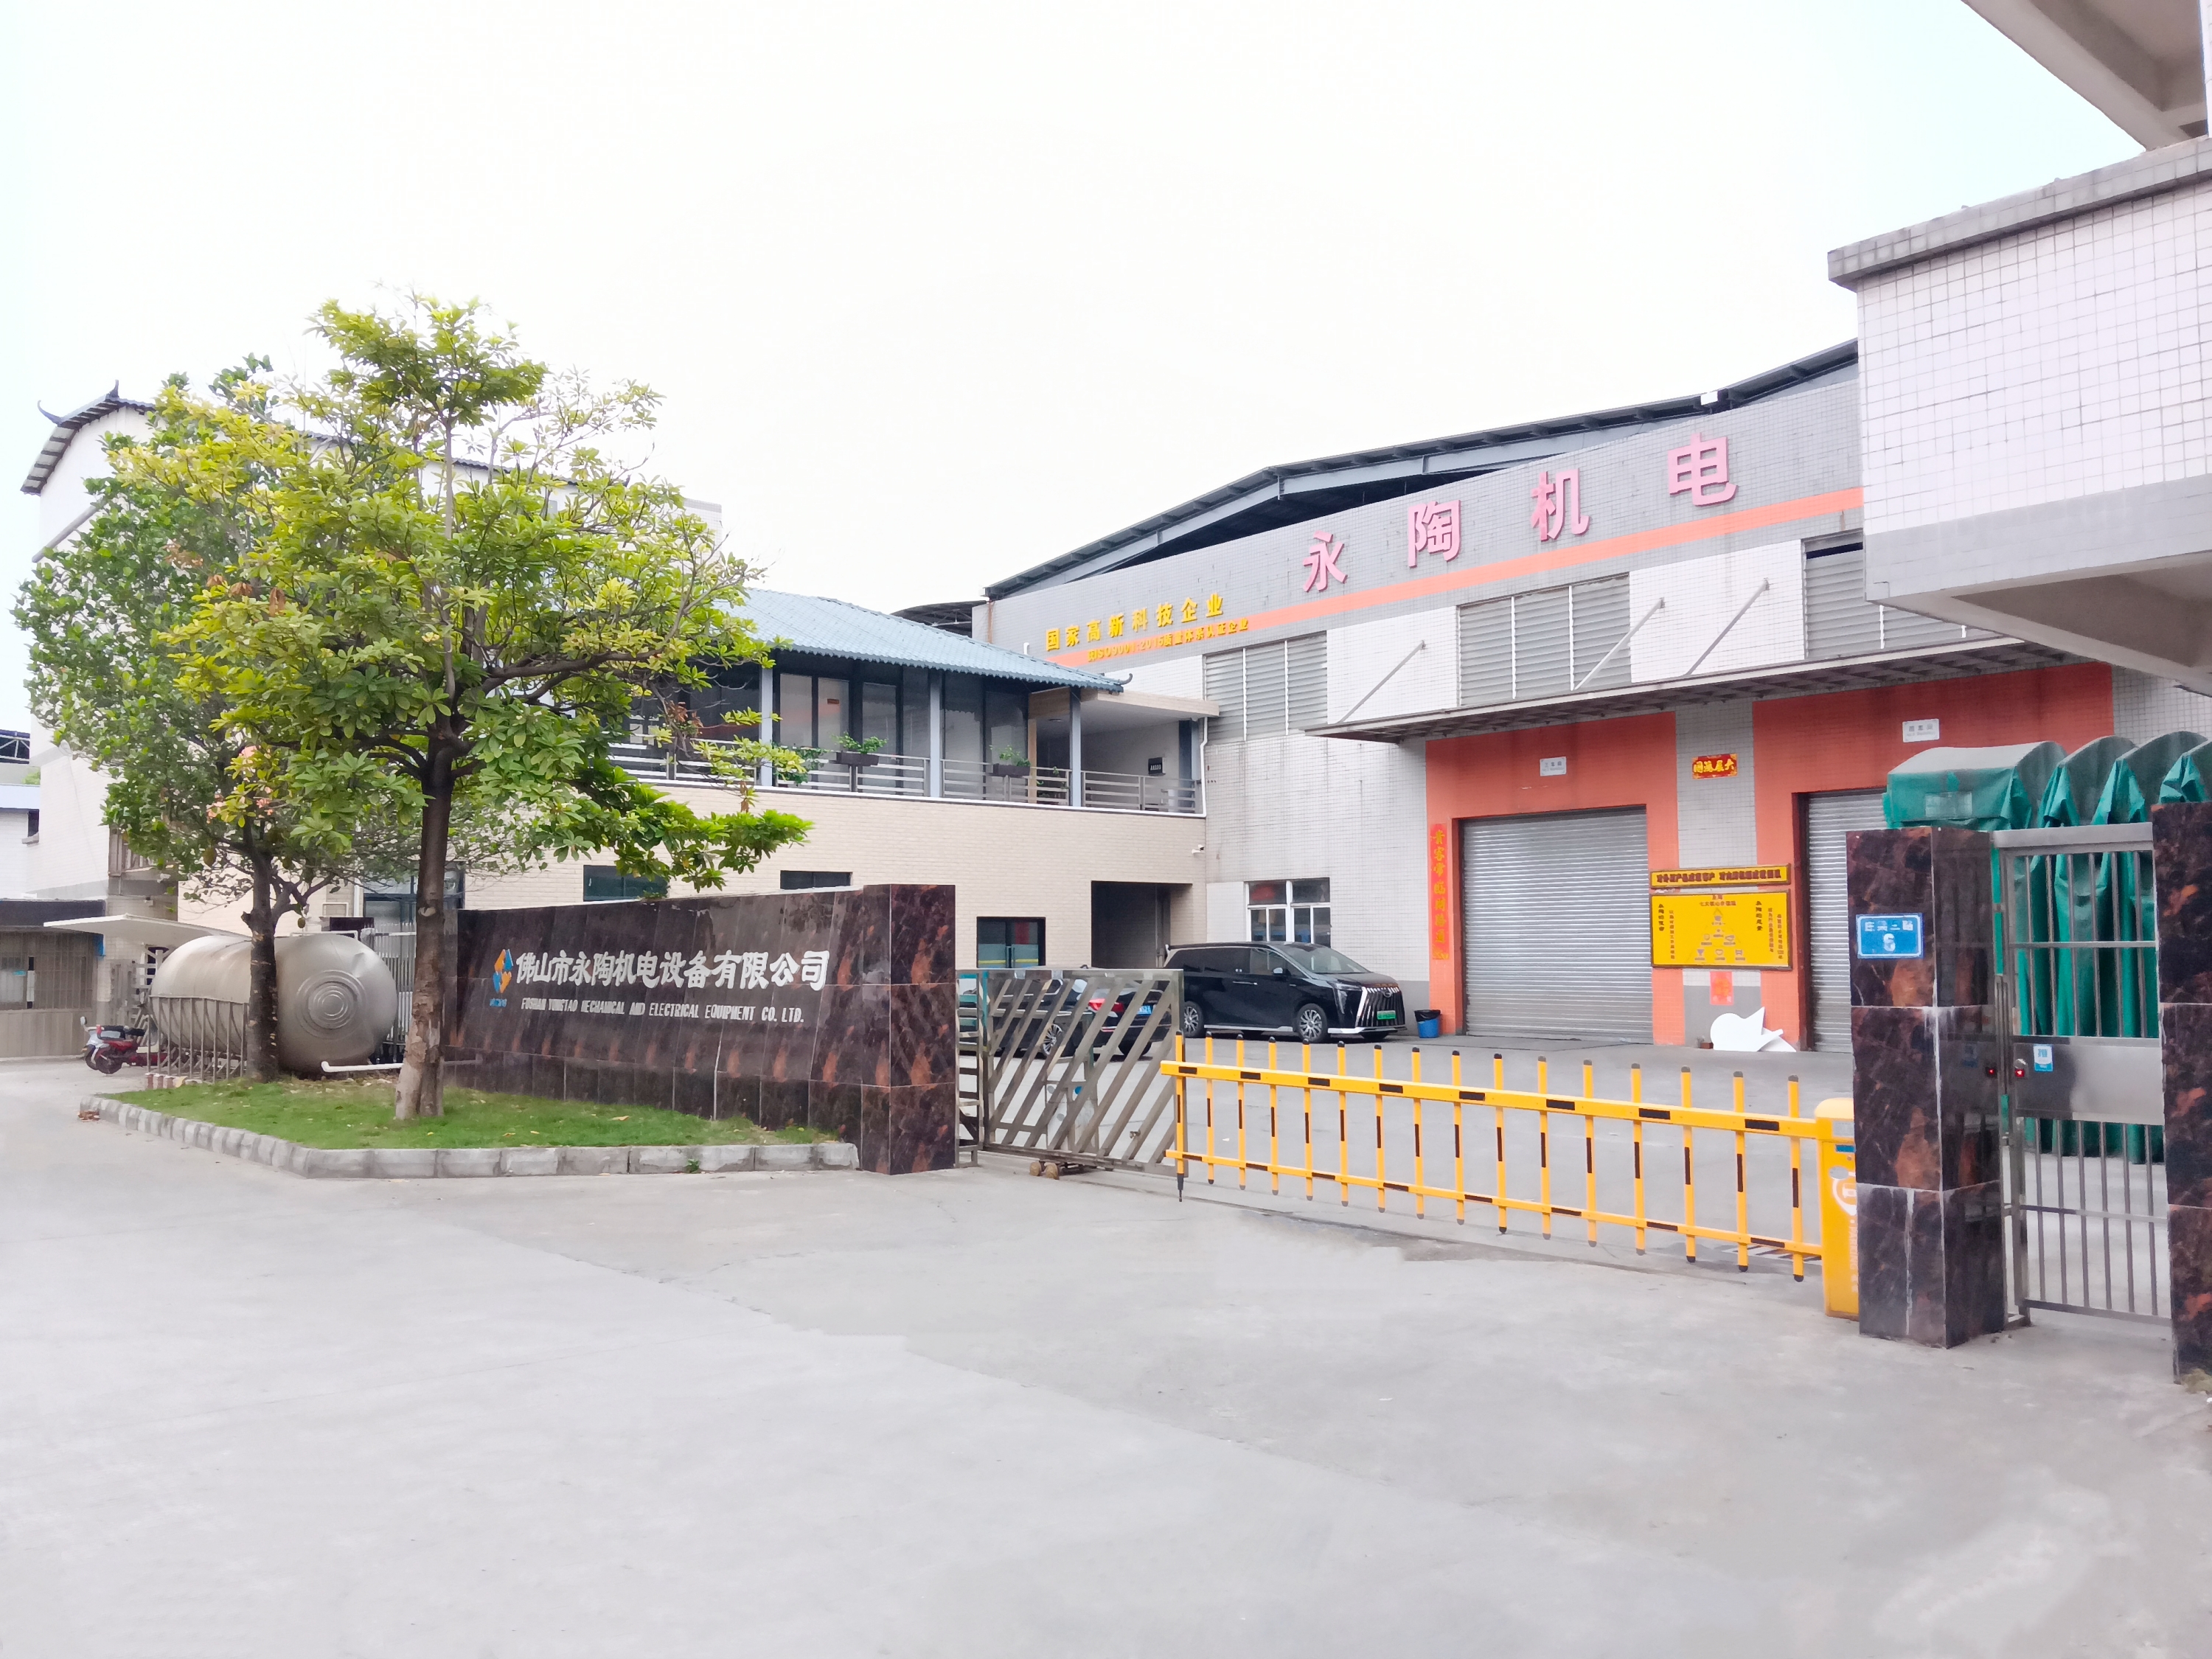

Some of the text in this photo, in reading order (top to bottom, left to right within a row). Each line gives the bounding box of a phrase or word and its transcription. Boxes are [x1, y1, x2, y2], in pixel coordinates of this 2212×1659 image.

[1302, 432, 1739, 593] 永陶机电
[1046, 592, 1224, 652] 国家高新科技企业
[516, 950, 830, 992] 佛山市永陶机电设备有限公司
[580, 1000, 625, 1015] MECHANICAL
[629, 1002, 646, 1016] AND
[649, 1003, 700, 1018] ELECTRICAL
[704, 1004, 756, 1020] EQUIPMENT
[762, 1006, 777, 1022] CO.
[782, 1007, 804, 1023] LTD.
